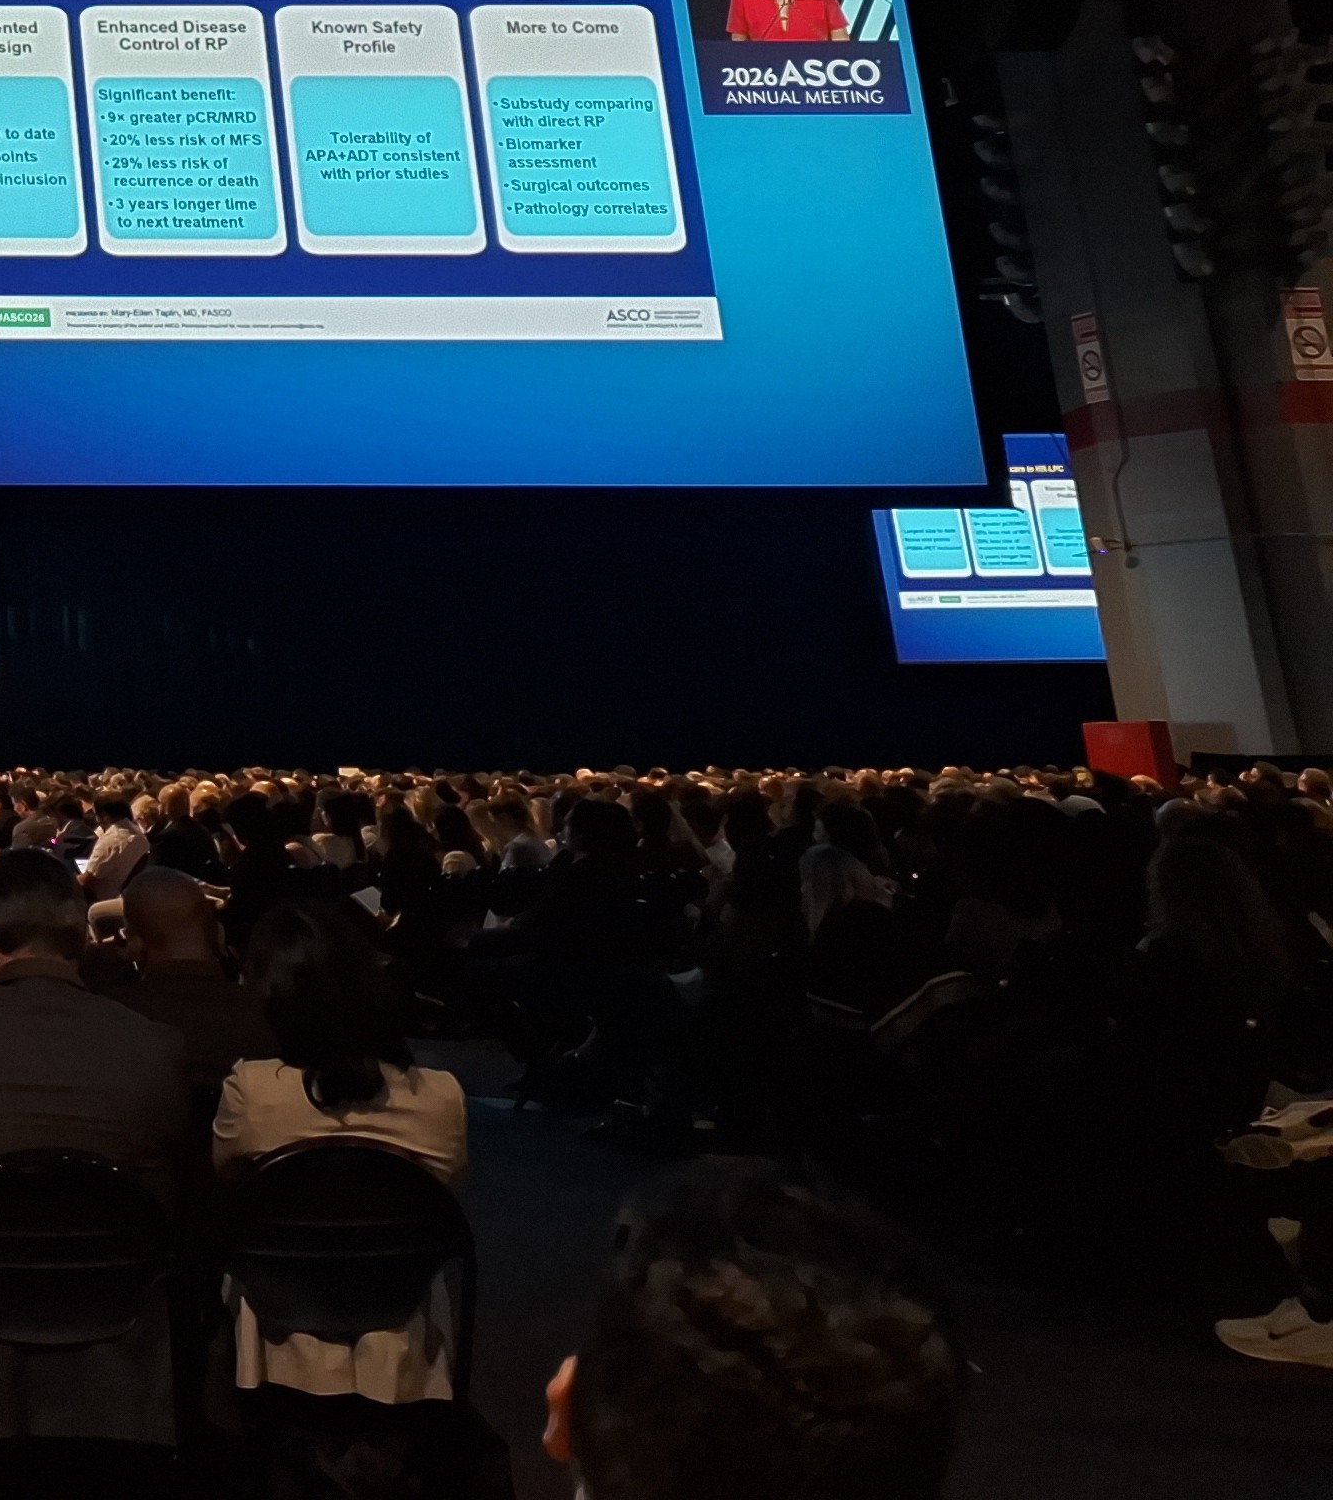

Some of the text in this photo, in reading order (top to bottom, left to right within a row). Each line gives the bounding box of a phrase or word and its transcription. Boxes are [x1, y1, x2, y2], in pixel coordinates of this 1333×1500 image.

[98, 20, 247, 35] Enhanced Disease
[312, 21, 422, 36] Known Safety
[507, 21, 619, 34] More to Come
[119, 37, 228, 52] Control of RP
[343, 41, 395, 54] Profile
[99, 89, 236, 102] Significant benefit:
[725, 89, 883, 106] ANNUAL MEETING
[501, 98, 654, 112] Substudy comparing
[130, 111, 181, 126] greater
[186, 111, 257, 126] pCR/MRD
[502, 116, 605, 128] with direct RP
[5, 128, 20, 140] to
[25, 128, 55, 140] date
[111, 134, 262, 147] 20% less risk of MFS
[330, 132, 431, 146] Tolerability of
[506, 138, 582, 151] Biomarker
[306, 150, 461, 162] APA+ADT consistent
[509, 156, 597, 169] assessment
[113, 158, 229, 170] 29% less risk of
[0, 173, 67, 186] inclusion
[321, 168, 449, 182] with prior studies
[114, 176, 259, 188] recurrence or death
[512, 179, 649, 192] Surgical outcomes
[117, 198, 257, 213] 3 years longer time
[514, 202, 667, 217] Pathology correlates
[118, 216, 244, 229] to next treatment
[607, 309, 650, 321] ASCO
